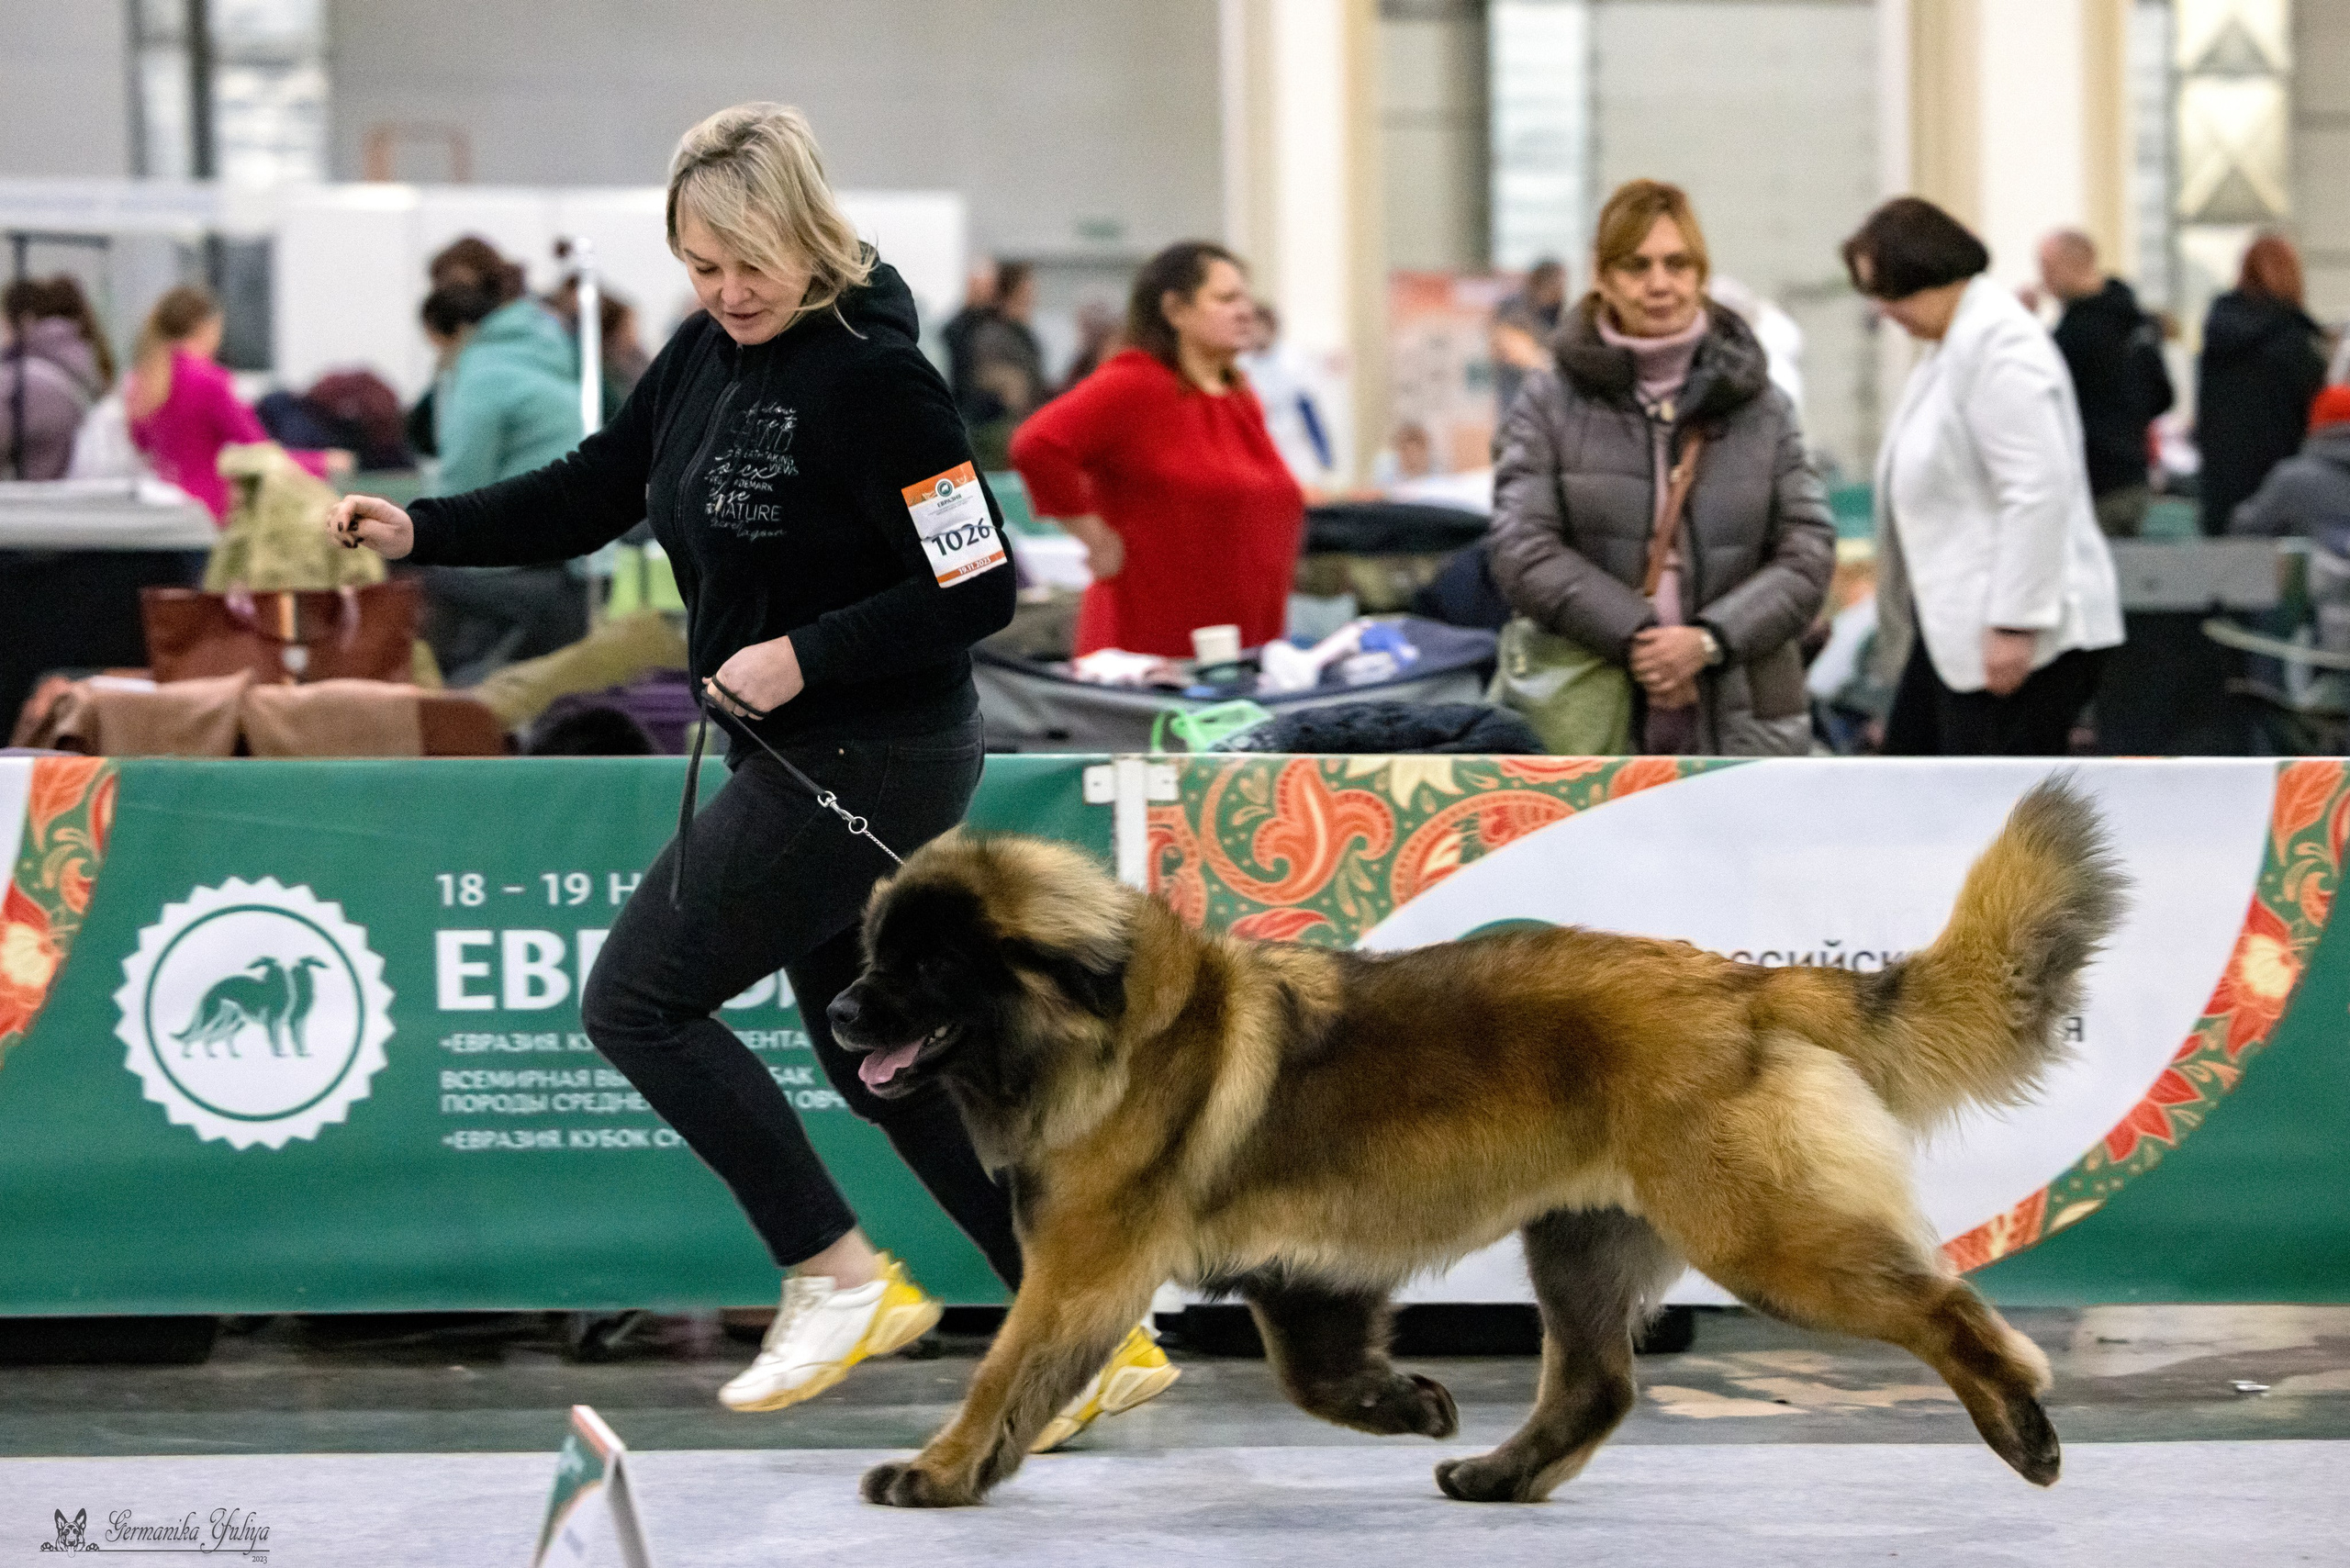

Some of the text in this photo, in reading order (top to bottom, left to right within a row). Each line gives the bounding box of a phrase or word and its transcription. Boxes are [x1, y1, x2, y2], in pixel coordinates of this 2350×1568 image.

[769, 463, 799, 476] VIEWS
[931, 517, 990, 556] 1026
[436, 872, 486, 906] 18
[542, 872, 592, 905] 19
